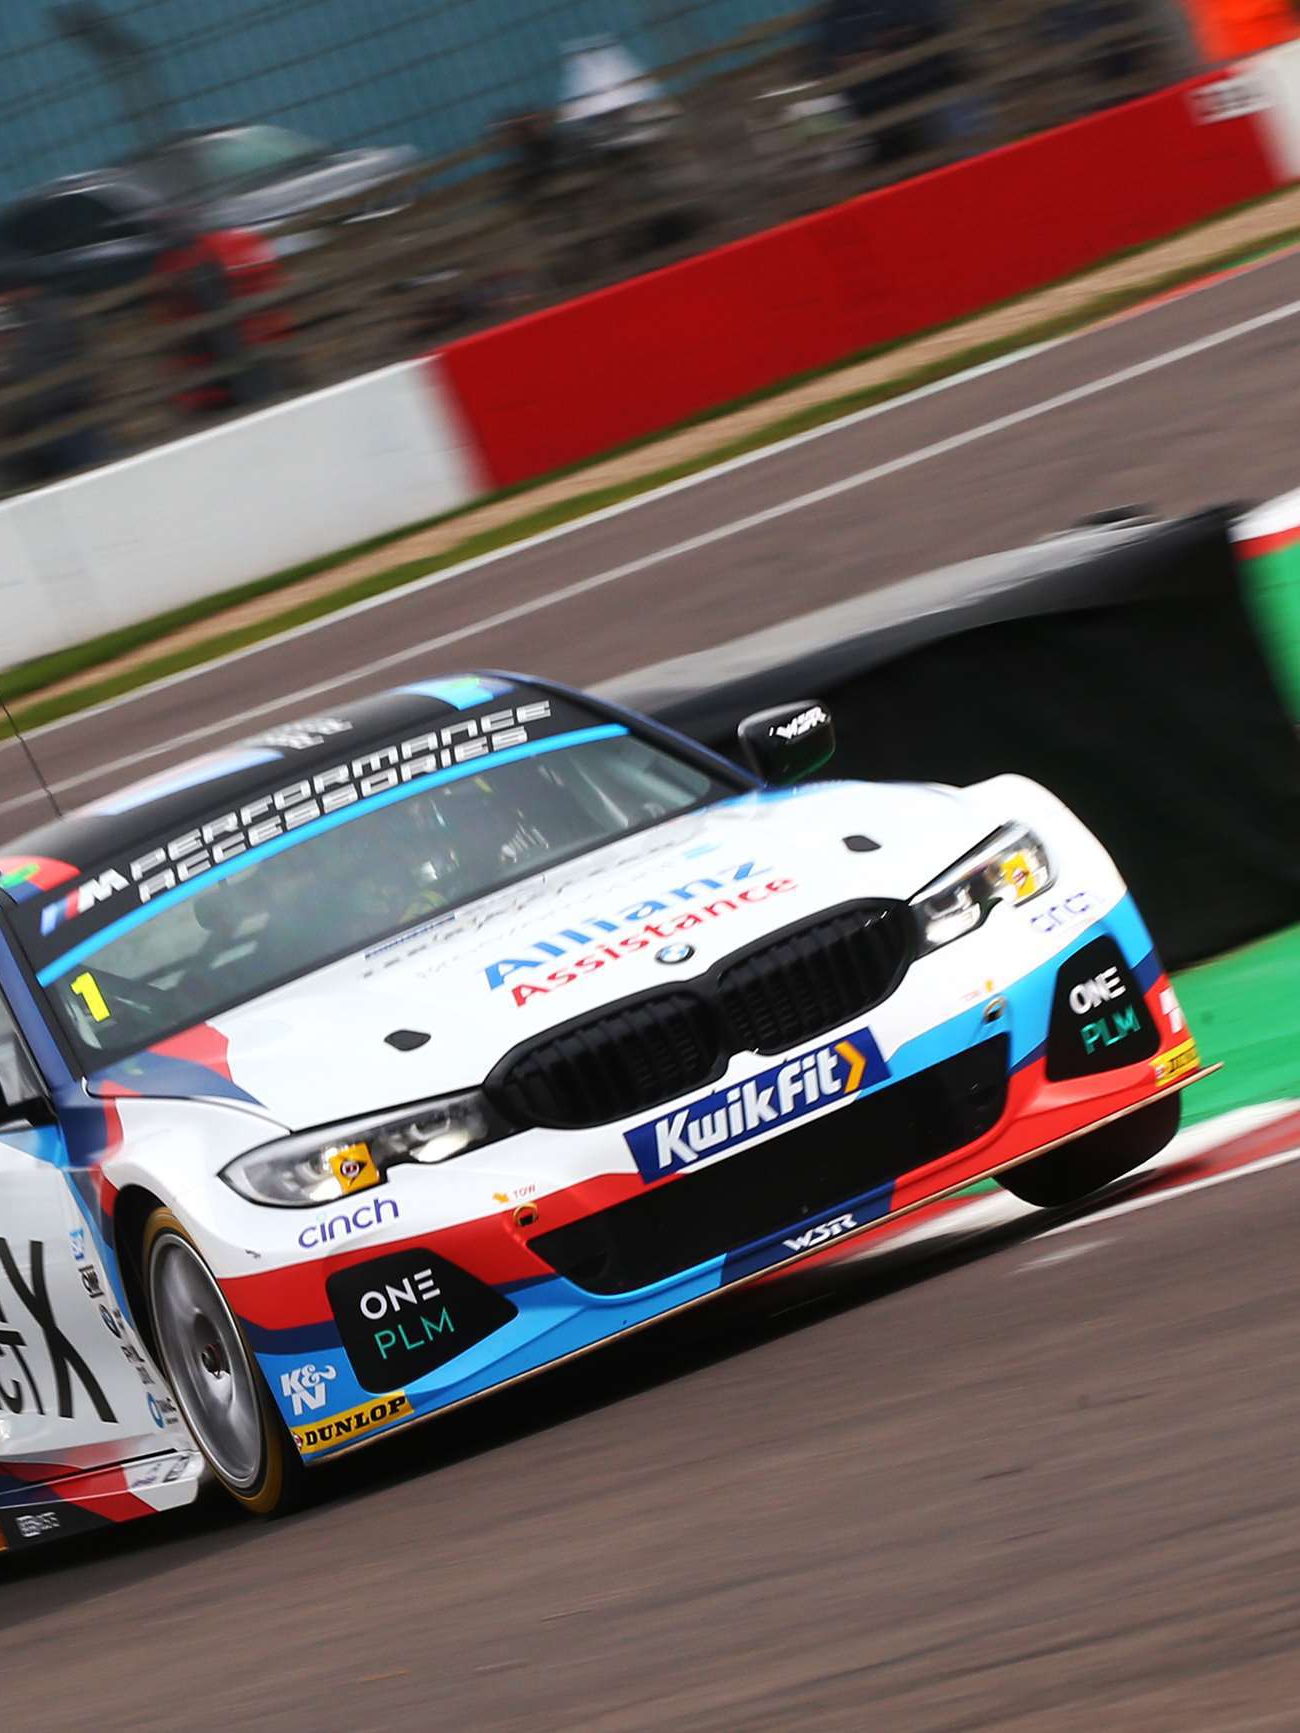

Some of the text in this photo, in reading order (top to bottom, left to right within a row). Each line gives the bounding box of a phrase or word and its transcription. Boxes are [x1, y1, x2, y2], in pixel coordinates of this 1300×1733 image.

[129, 700, 552, 879] PERFORMANCE
[138, 726, 529, 904] ACCESSORIES
[484, 861, 775, 991] Allianz
[511, 878, 798, 1008] Assistance
[69, 972, 111, 1023] 1
[1069, 966, 1127, 1015] ONE
[1080, 1005, 1141, 1055] PLM
[298, 1198, 399, 1249] cinch
[782, 1213, 857, 1252] WSR
[360, 1268, 441, 1320] ONE
[373, 1307, 454, 1359] PLM
[305, 1396, 407, 1447] DUNLOP
